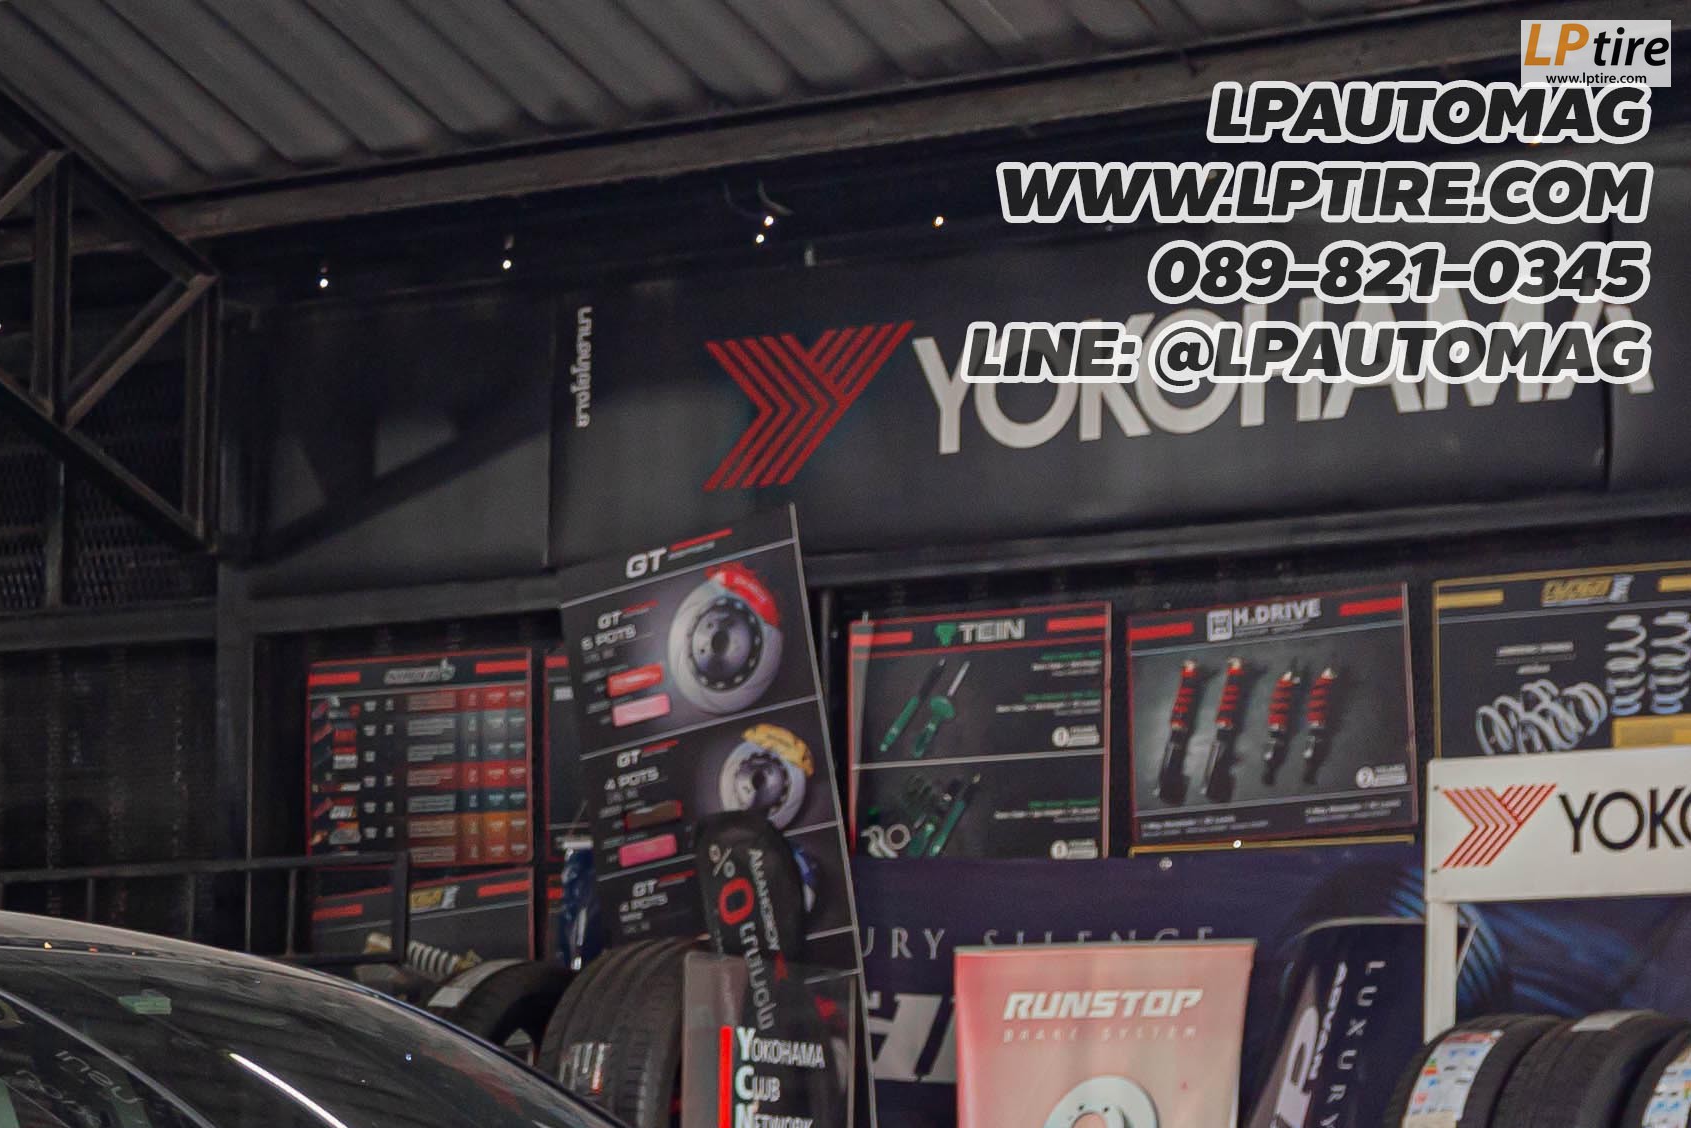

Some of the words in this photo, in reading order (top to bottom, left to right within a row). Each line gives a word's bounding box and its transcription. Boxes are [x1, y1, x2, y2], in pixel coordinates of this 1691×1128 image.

[626, 547, 668, 579] GT
[597, 611, 622, 630] GT
[1233, 598, 1322, 627] H.DRIVE
[959, 618, 1025, 643] TEIN
[616, 749, 641, 768] GT
[617, 766, 660, 788] POTS
[1559, 785, 1691, 854] YOK
[1003, 988, 1204, 1022] RUNSTOP
[736, 1026, 827, 1069] YOKOHAMA
[735, 1065, 781, 1102] CLUB
